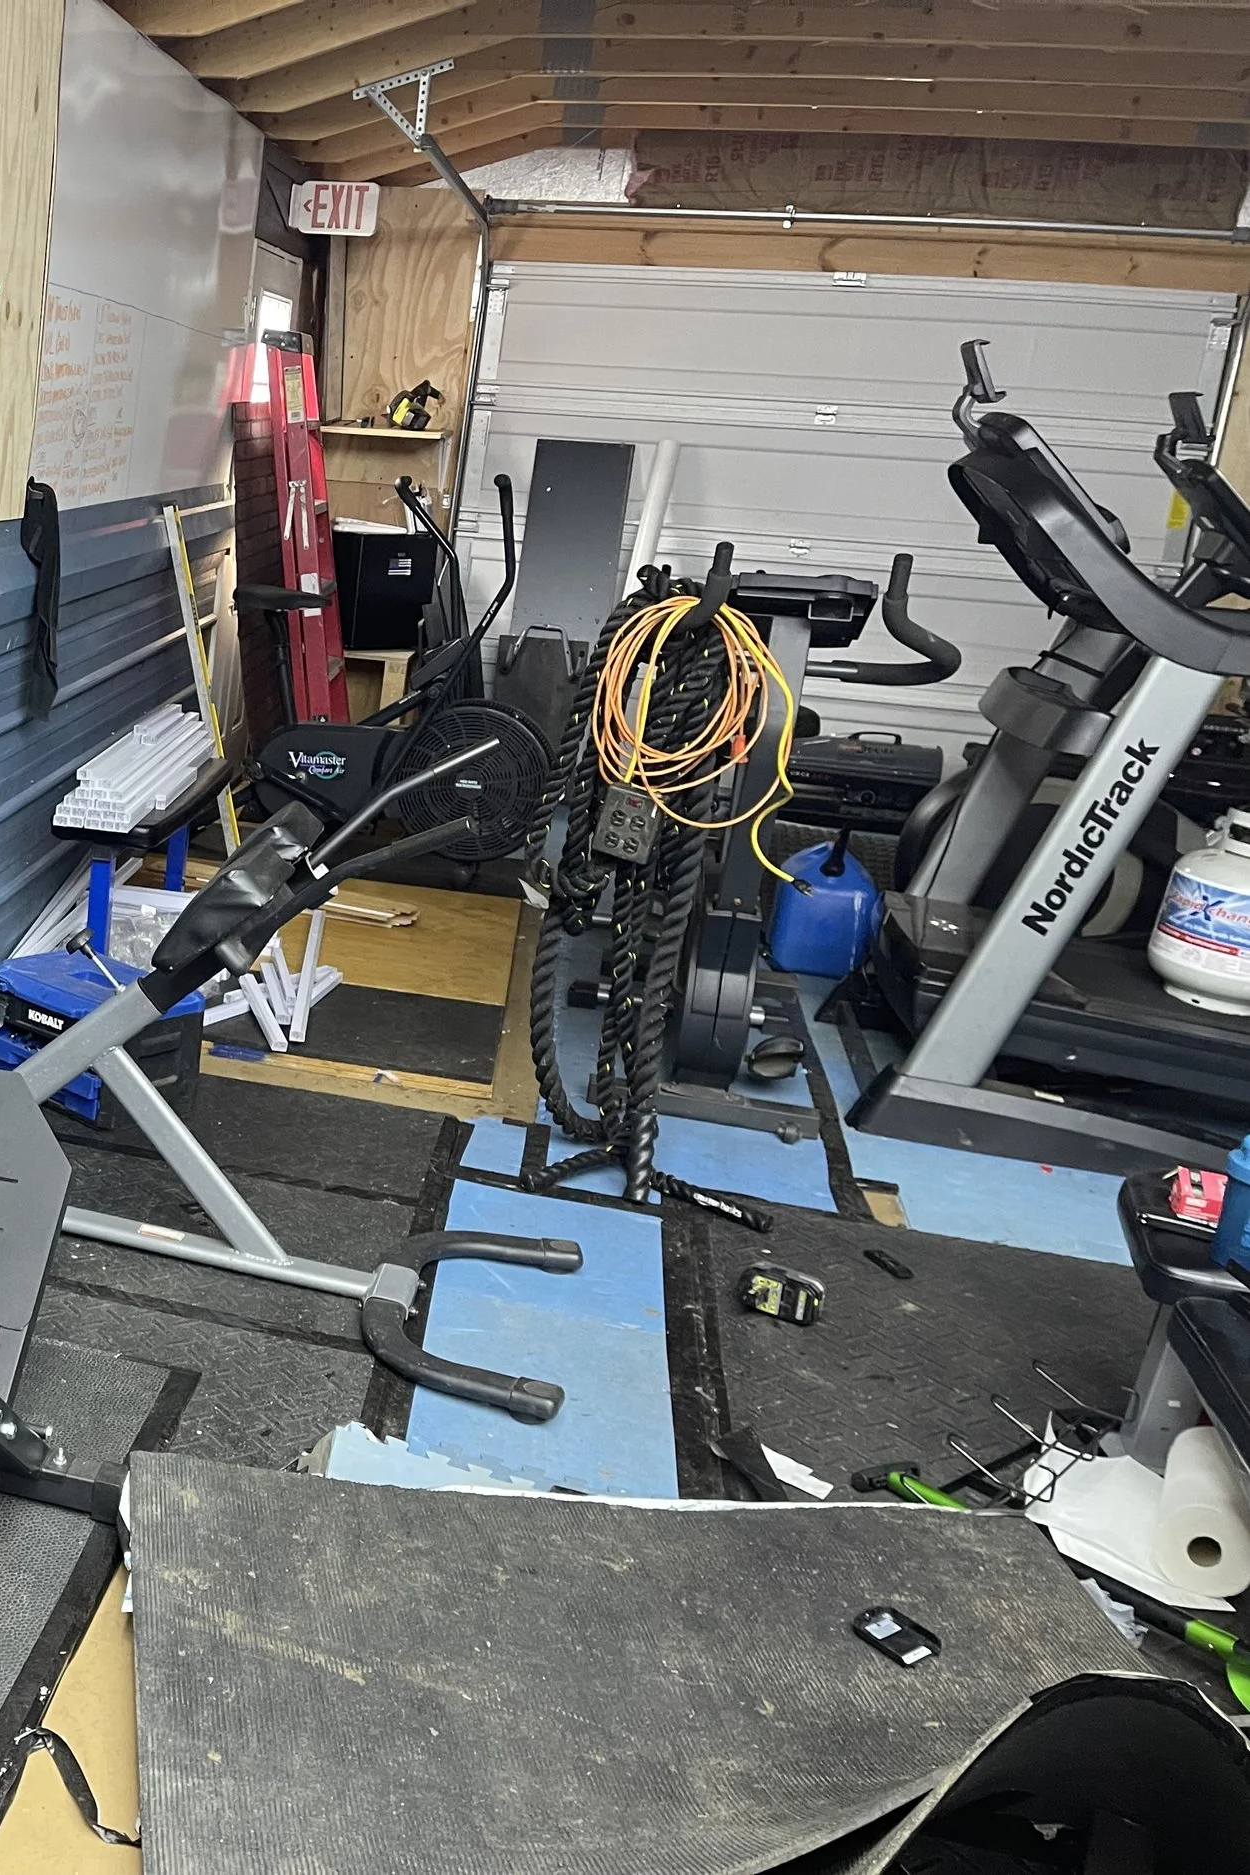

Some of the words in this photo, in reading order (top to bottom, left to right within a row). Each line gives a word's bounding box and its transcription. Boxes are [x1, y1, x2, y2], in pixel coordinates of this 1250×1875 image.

[310, 183, 370, 230] EXIT
[288, 750, 347, 769] Vitamaster
[308, 765, 333, 775] Comfort
[1021, 737, 1161, 937] NordicTrack
[28, 1008, 65, 1031] KOBALT
